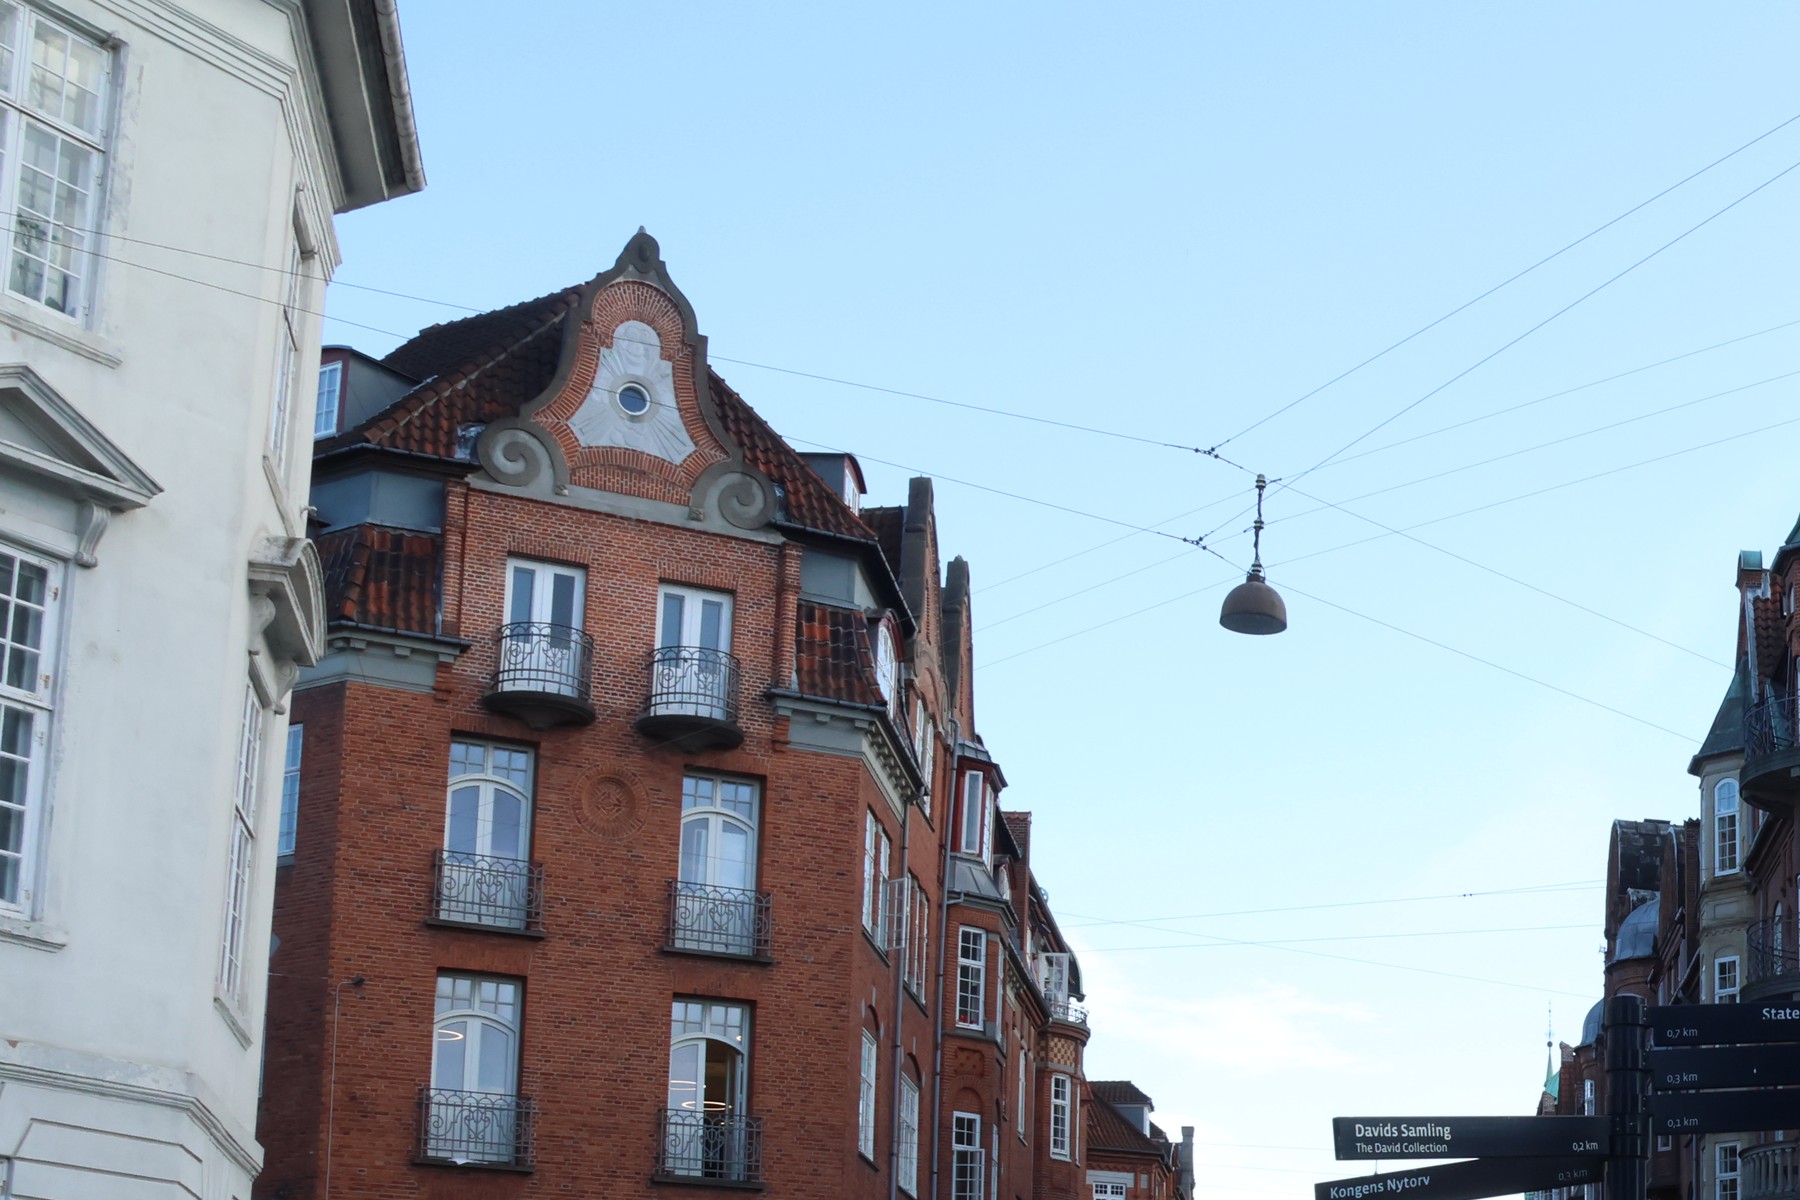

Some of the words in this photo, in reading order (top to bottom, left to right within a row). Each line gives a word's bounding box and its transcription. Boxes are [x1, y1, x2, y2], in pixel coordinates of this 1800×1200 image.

[1667, 1029, 1680, 1038] 0,7
[1683, 1027, 1698, 1037] km
[1667, 1074, 1680, 1084] 0,3
[1683, 1072, 1698, 1082] km
[1667, 1119, 1681, 1128] 0,1
[1683, 1117, 1699, 1127] km
[1355, 1123, 1398, 1137] Davids
[1400, 1123, 1452, 1140] Samling
[1356, 1143, 1373, 1153] The
[1375, 1143, 1400, 1153] David
[1402, 1143, 1448, 1153] Collection
[1572, 1142, 1584, 1152] 0,2
[1585, 1140, 1598, 1150] km
[1558, 1171, 1571, 1181] 0,3
[1573, 1169, 1588, 1179] km
[1330, 1181, 1384, 1199] Kongens
[1387, 1175, 1430, 1193] Nytorv
